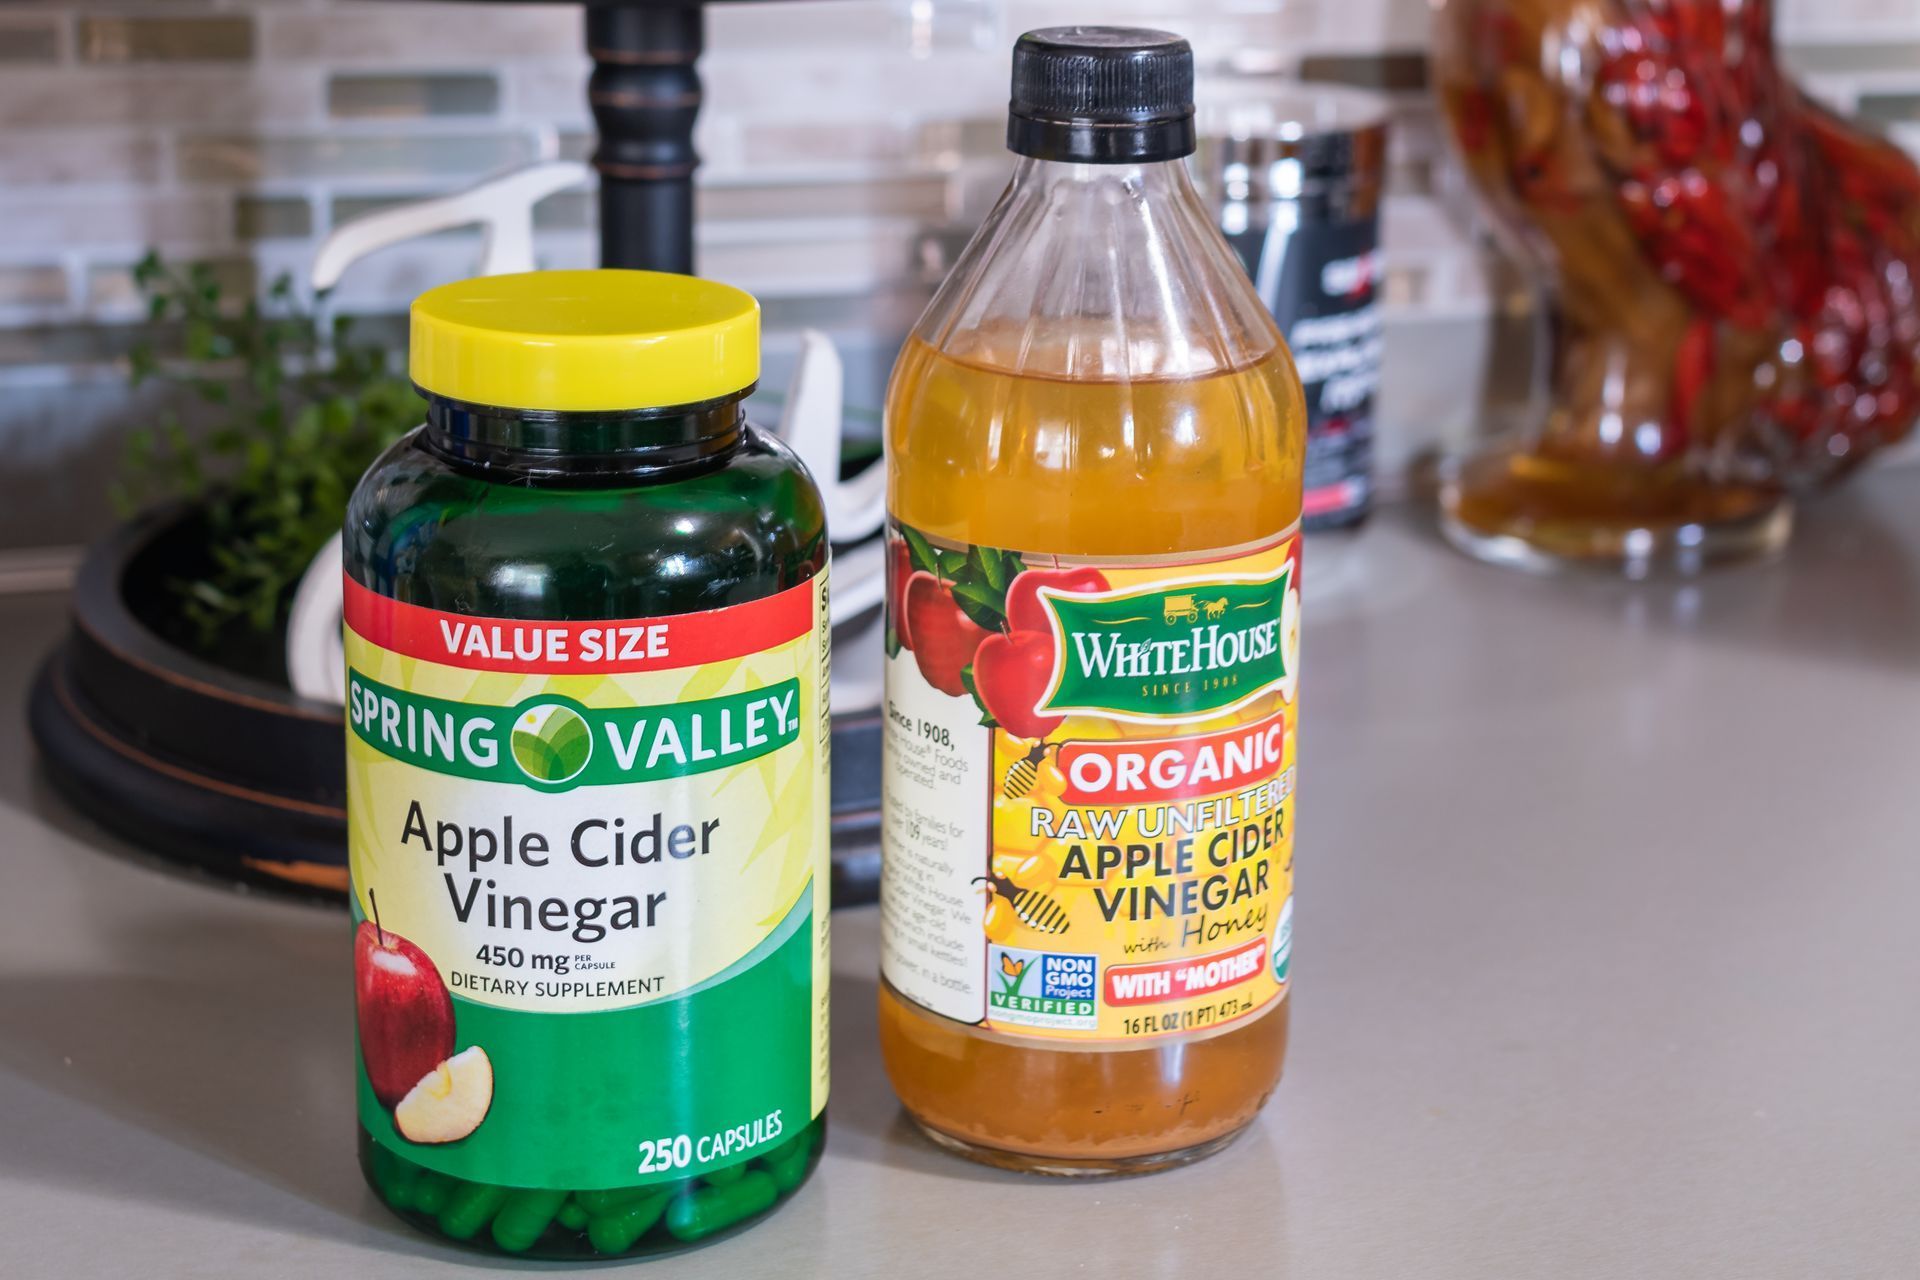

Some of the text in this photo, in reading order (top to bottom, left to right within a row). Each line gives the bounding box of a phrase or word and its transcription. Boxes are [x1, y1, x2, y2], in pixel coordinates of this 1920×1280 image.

[439, 619, 670, 662] VALUE SIZE
[1142, 674, 1239, 697] SINCE 1908
[349, 678, 499, 768] SPRING
[604, 689, 795, 771] VALLEY
[917, 718, 955, 752] 1908,
[934, 748, 969, 772] Foods
[1070, 722, 1281, 793] ORGANIC
[938, 769, 962, 786] and
[1031, 764, 1296, 840] RAW UNFILTERED
[401, 799, 721, 873] Apple Cider
[1058, 808, 1285, 880] APPLE CIDER
[1093, 858, 1270, 922] VINEGAR
[443, 872, 668, 943] Vinegar
[1123, 935, 1171, 955] with
[1180, 902, 1269, 948] Honey
[475, 943, 571, 976] 450 mg
[574, 954, 592, 963] PER
[574, 961, 616, 971] CAPSULE
[1046, 957, 1093, 974] NON
[451, 971, 665, 999] DIETARY SUPPLEMENT
[1045, 971, 1093, 988] GMO
[1045, 985, 1092, 1000] Project
[1112, 970, 1171, 1000] WITH
[994, 994, 1093, 1016] VERIFIED
[1124, 1018, 1140, 1034] 16
[1144, 1016, 1159, 1033] FL
[1161, 1013, 1178, 1030] OZ
[1219, 1000, 1238, 1018] 473
[637, 1109, 783, 1174] 250 CAPSULES
